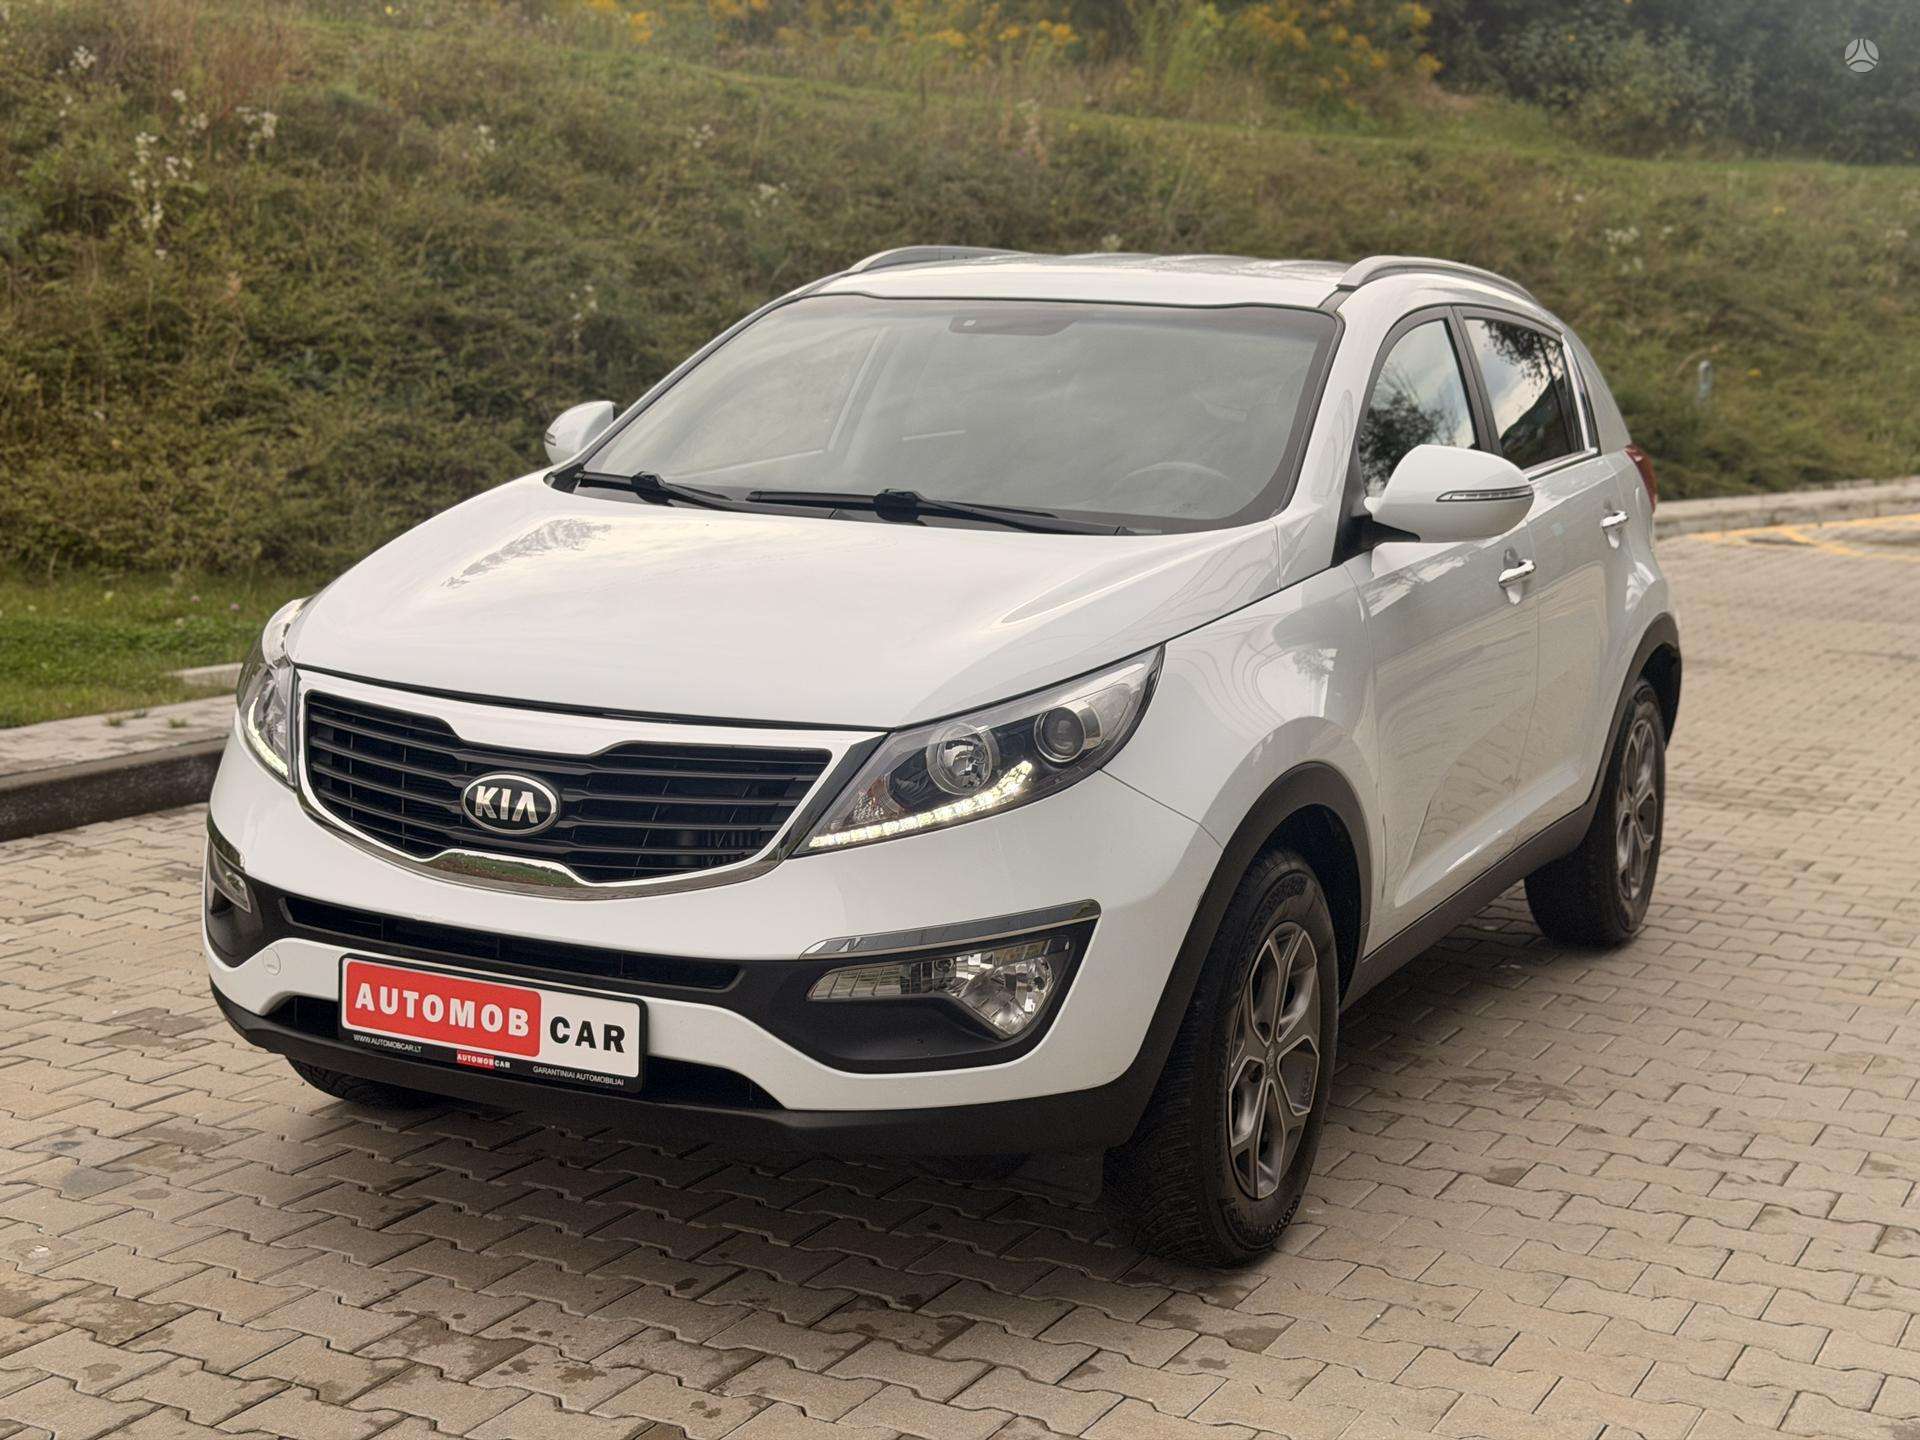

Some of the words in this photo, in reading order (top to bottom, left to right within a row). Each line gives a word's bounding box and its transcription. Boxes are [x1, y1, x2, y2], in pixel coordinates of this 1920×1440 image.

[475, 785, 538, 823] KIA
[355, 982, 529, 1037] AUTOMOB
[549, 1016, 625, 1053] CAR
[533, 1065, 575, 1079] GARANTINIAI
[576, 1073, 624, 1086] AUTOMOBILIAI
